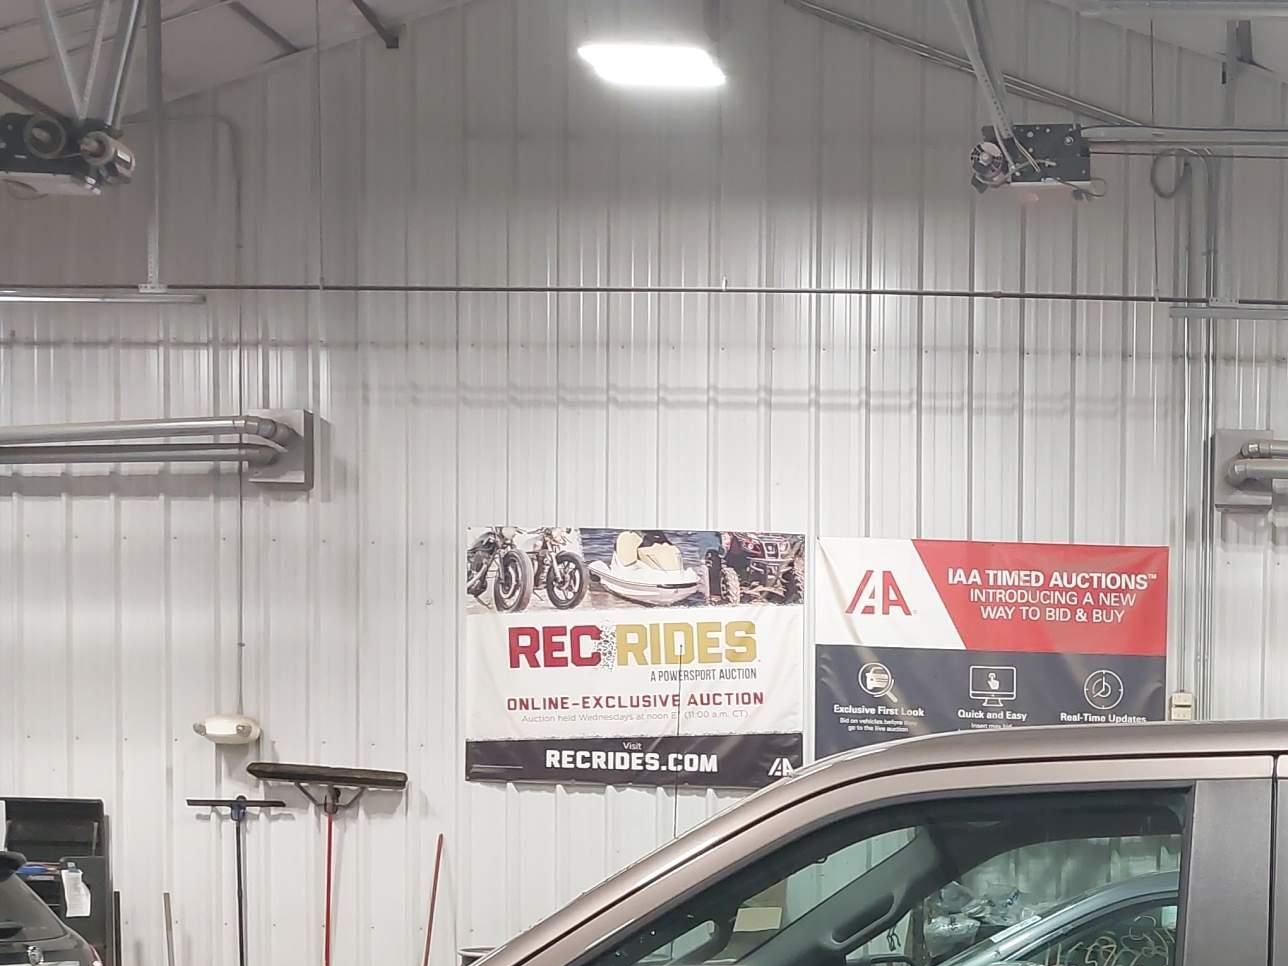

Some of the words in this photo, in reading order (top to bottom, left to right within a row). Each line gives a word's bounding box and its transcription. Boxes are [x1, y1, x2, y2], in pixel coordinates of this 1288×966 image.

[947, 567, 981, 585] IAA
[985, 569, 1044, 587] TIMED
[970, 588, 1077, 605] INTRODUCING
[1082, 593, 1094, 605] A
[1099, 593, 1136, 606] NEW
[981, 605, 1016, 620] WAY
[1019, 606, 1040, 620] TO
[1046, 606, 1071, 622] BID
[1075, 609, 1088, 622] &
[1093, 609, 1125, 623] BUY
[508, 625, 602, 669] REC
[615, 620, 757, 667] RIDES
[650, 670, 656, 682] A
[658, 669, 716, 682] POWERSPORT
[719, 668, 757, 680] AUCTION
[507, 694, 680, 711] ONLINE-EXCLUSIVE
[687, 692, 764, 707] AUCTION
[522, 713, 555, 723] Auction
[558, 713, 576, 722] held
[833, 704, 876, 715] Exclusive
[877, 705, 899, 716] First
[901, 707, 925, 717] Look
[957, 709, 985, 720] Quick
[986, 711, 1004, 720] and
[1006, 711, 1027, 722] Easy
[1060, 712, 1106, 723] Real-Time
[1108, 713, 1147, 725] Updates
[623, 741, 642, 750] Visit
[545, 749, 718, 773] RECRIDES.COM
